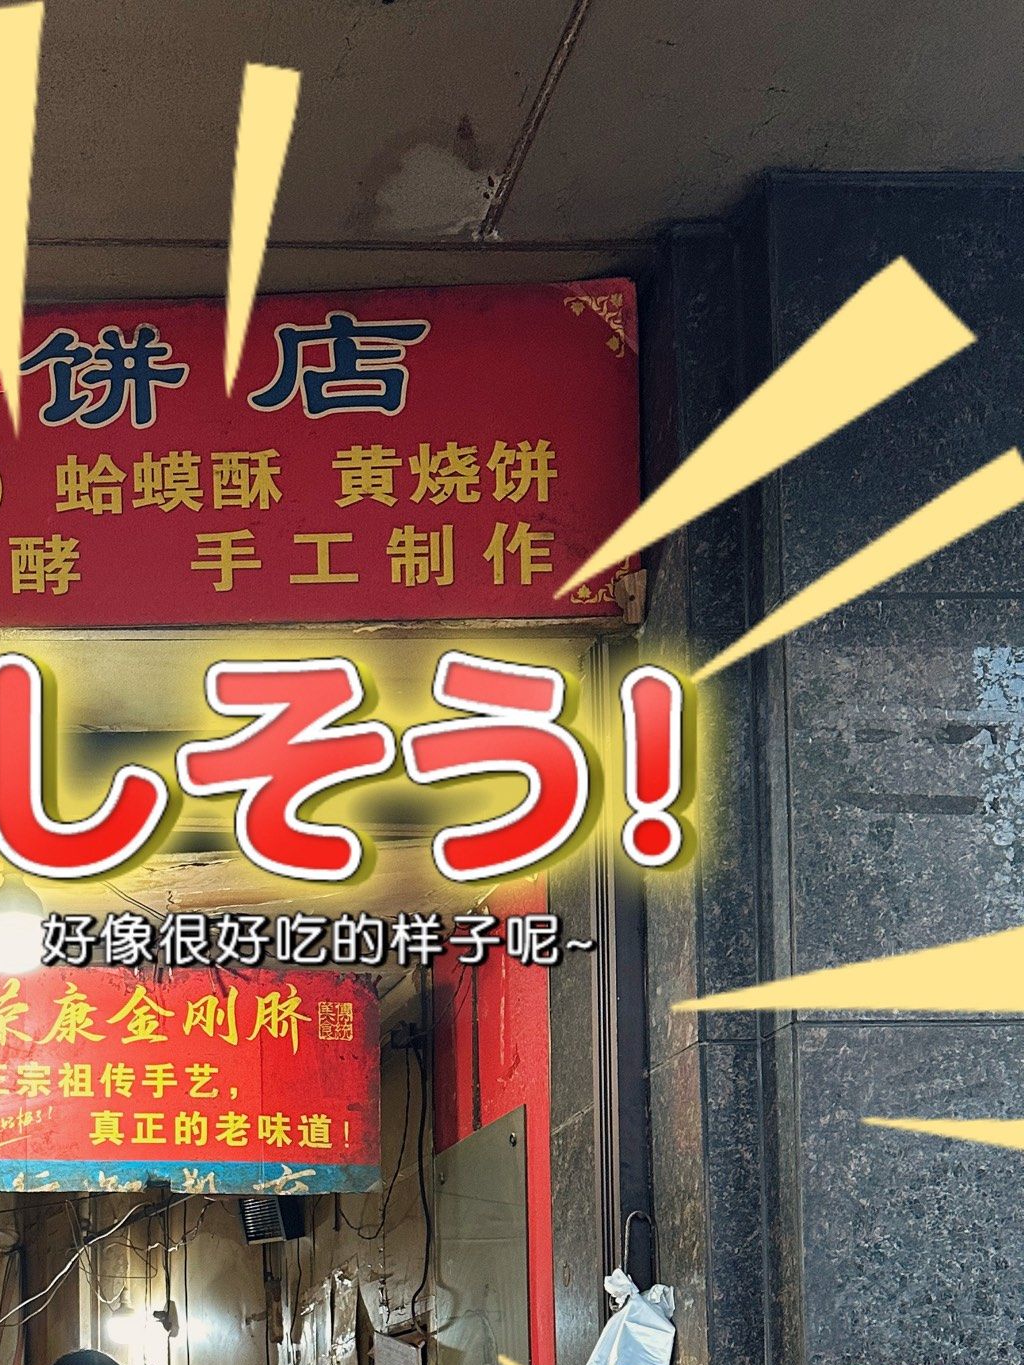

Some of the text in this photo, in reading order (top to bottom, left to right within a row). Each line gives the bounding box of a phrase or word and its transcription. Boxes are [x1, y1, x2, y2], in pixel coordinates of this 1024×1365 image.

[54, 447, 282, 516] 蛤蟆酥
[331, 438, 559, 507] 黄烧饼
[190, 521, 554, 593] 手工制作
